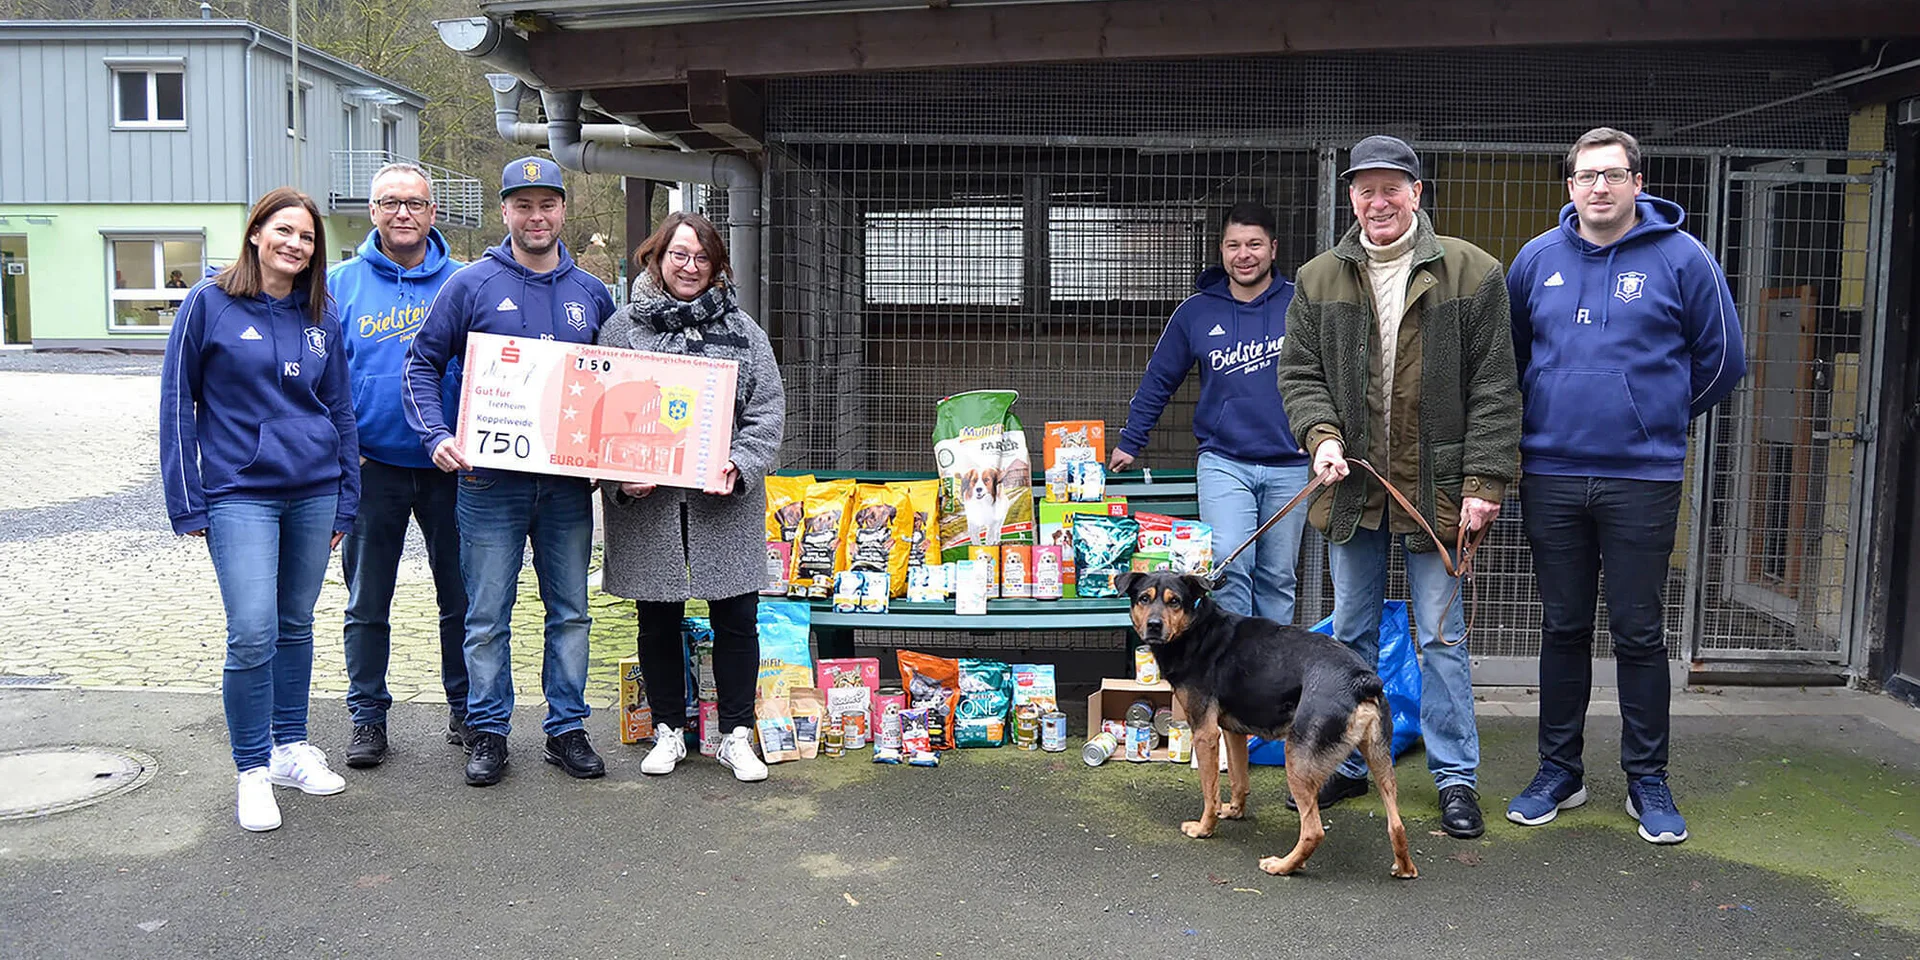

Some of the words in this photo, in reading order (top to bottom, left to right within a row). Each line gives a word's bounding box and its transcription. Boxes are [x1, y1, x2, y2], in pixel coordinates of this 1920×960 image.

[1577, 308, 1591, 324] FL
[581, 347, 618, 358] Sparkasse
[620, 351, 632, 359] der
[634, 353, 691, 366] Homburgischen
[693, 358, 735, 369] Gemeinden
[1208, 335, 1286, 371] Bielstene
[284, 362, 300, 376] KS
[475, 386, 493, 396] Gut
[488, 400, 526, 410] Tierheim
[477, 414, 533, 428] Koppelweide
[963, 423, 1005, 437] MultiFit
[477, 430, 530, 459] 750
[550, 454, 584, 467] EURO
[760, 658, 782, 668] ltiFit
[960, 700, 998, 717] ONE
